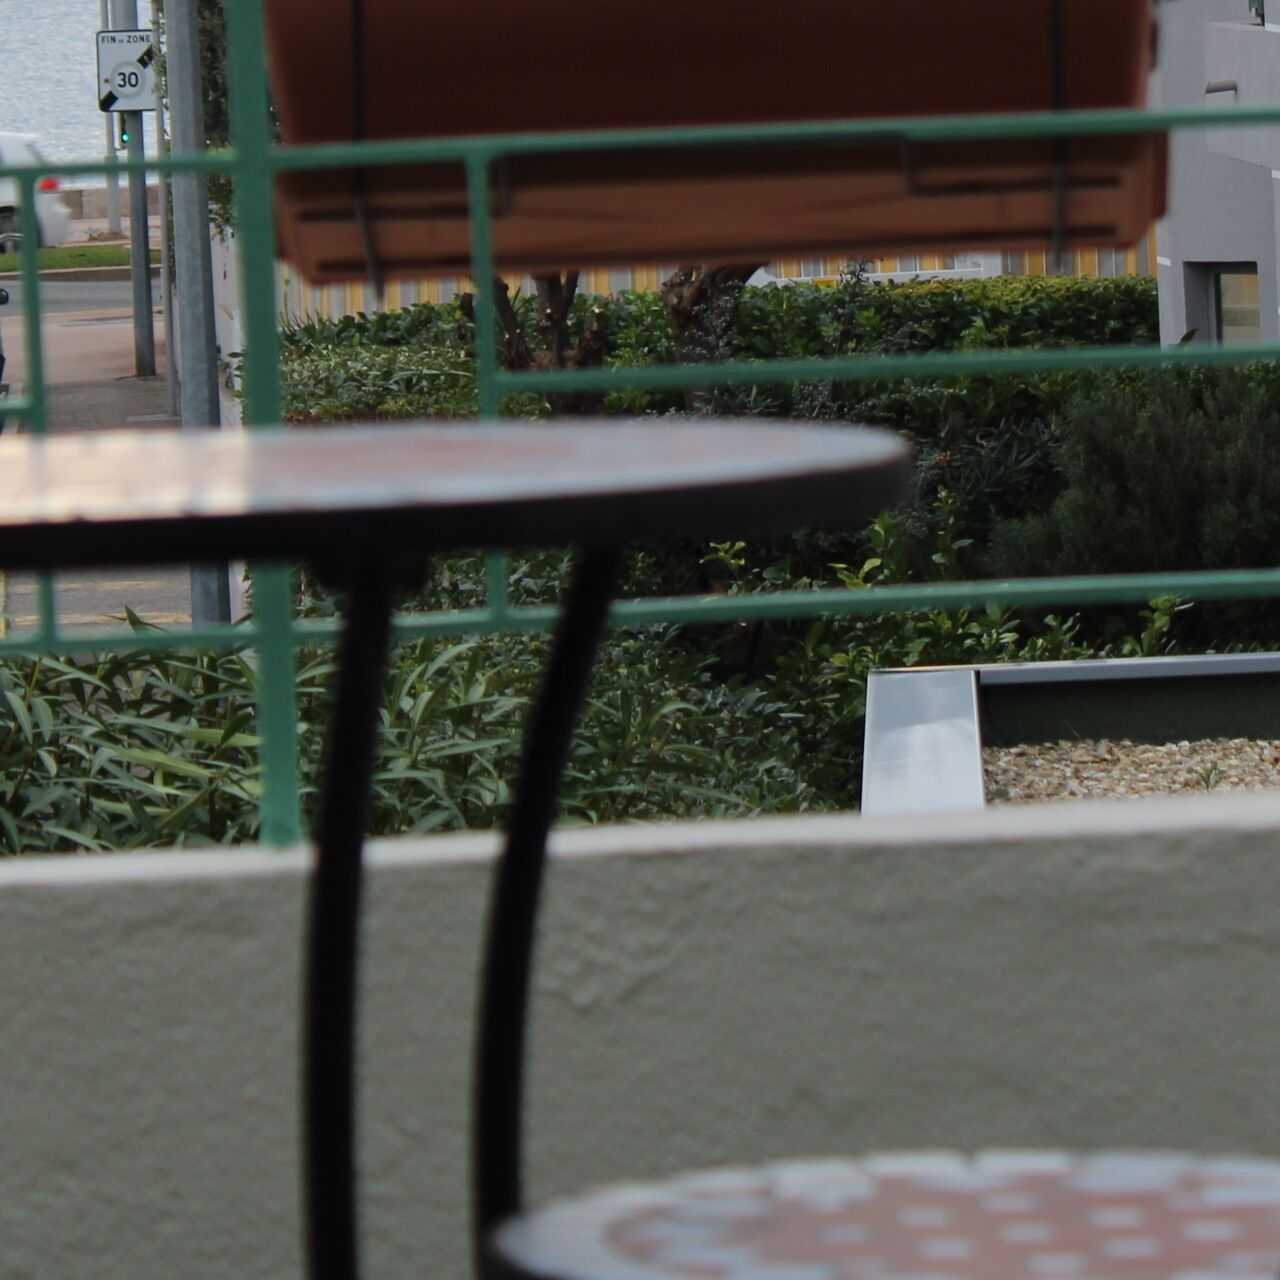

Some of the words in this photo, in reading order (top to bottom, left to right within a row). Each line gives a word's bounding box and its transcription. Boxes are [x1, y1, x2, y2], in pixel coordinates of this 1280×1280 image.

[100, 35, 116, 45] FIN
[126, 34, 151, 44] ZONE
[117, 71, 139, 88] 30
